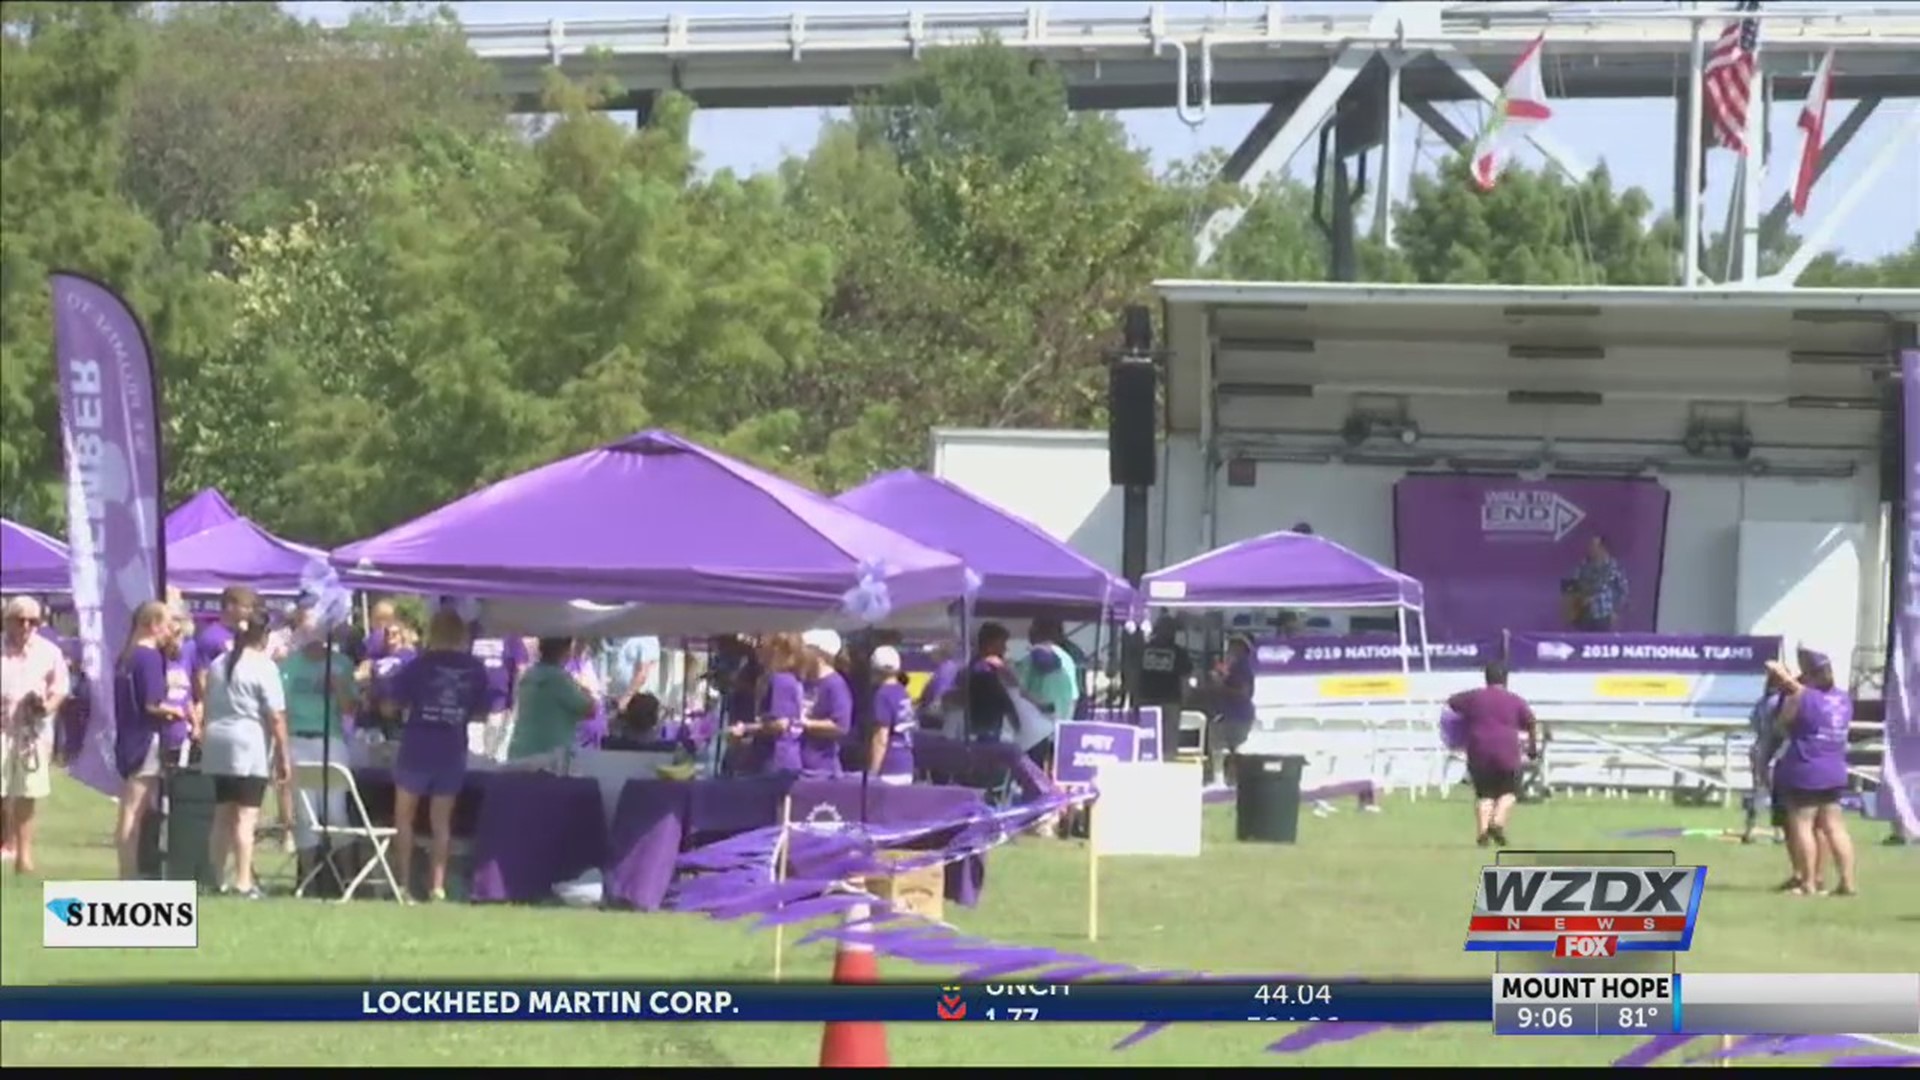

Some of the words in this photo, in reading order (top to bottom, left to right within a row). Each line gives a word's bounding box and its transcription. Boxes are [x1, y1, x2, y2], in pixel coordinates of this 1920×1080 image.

[1486, 506, 1550, 519] END
[1304, 646, 1342, 660] 2019
[1582, 645, 1619, 658] 2019
[1622, 645, 1699, 659] NATIONAL
[1703, 645, 1753, 660] TEAMS
